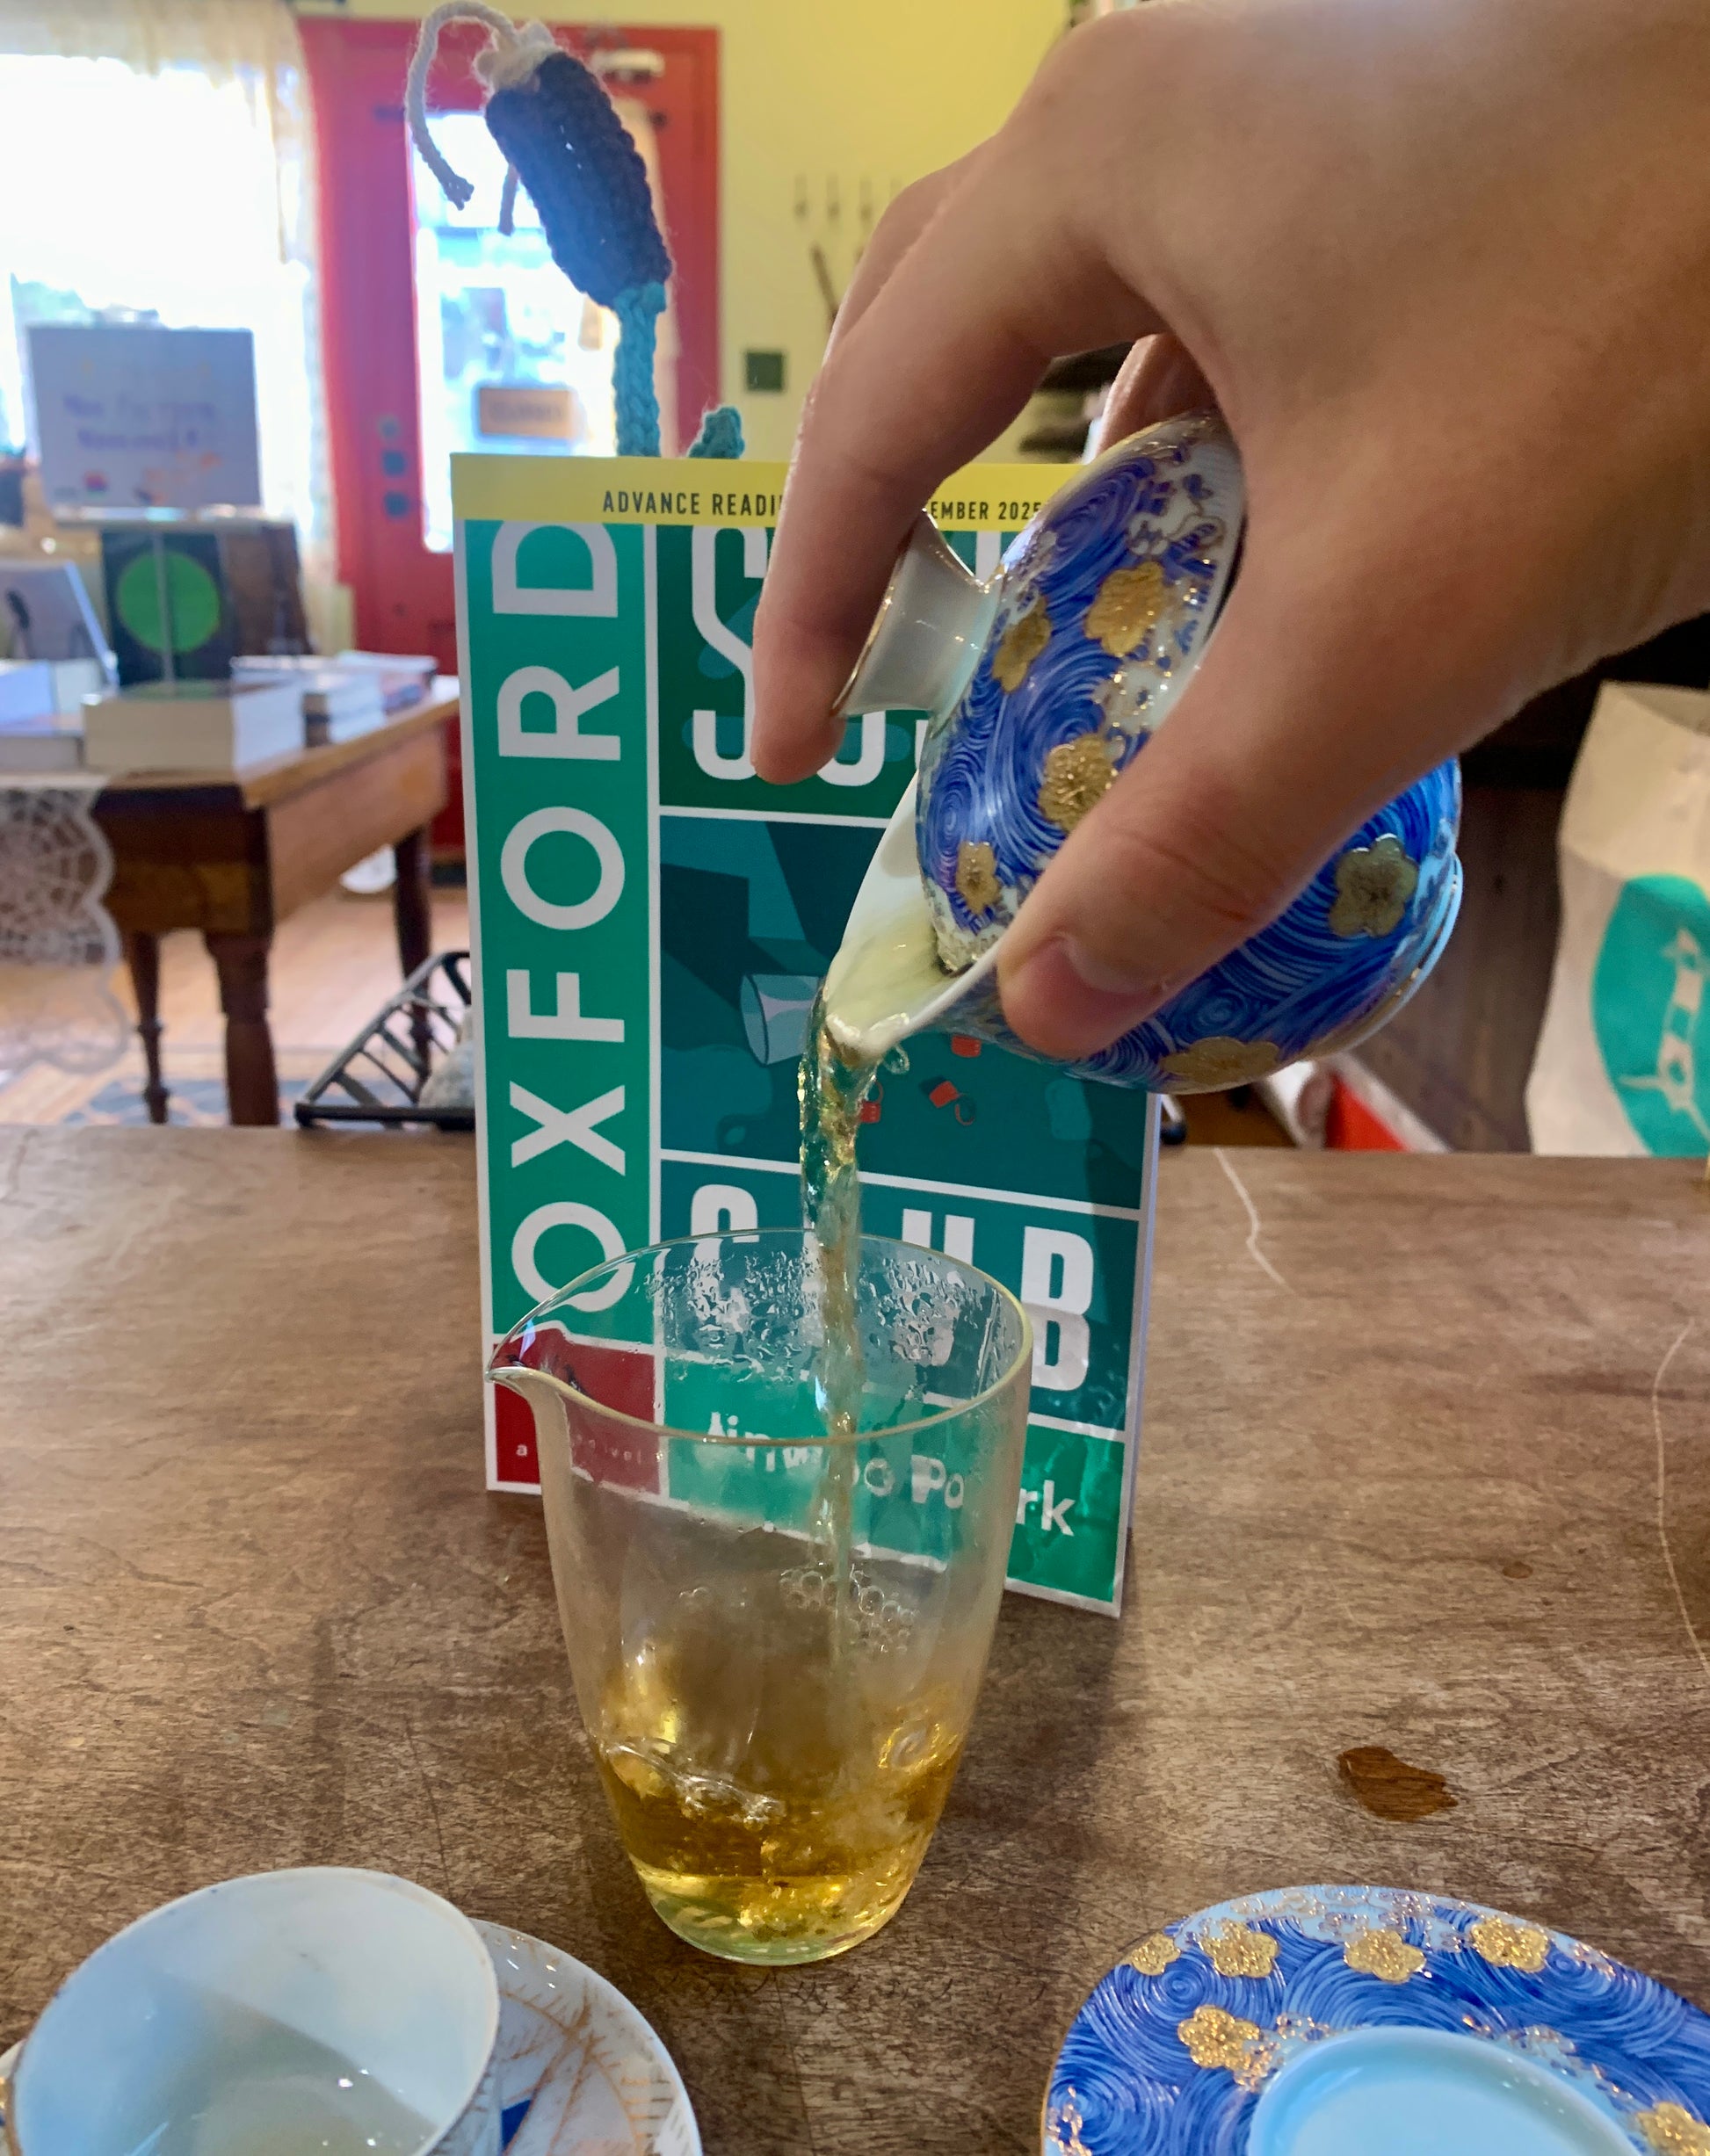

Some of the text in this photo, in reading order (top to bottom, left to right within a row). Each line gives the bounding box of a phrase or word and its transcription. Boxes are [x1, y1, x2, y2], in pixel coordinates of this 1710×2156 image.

[603, 490, 700, 515] ADVANCE
[712, 493, 783, 517] READI
[930, 500, 989, 521] EMBER
[492, 520, 635, 1313] OXFORD
